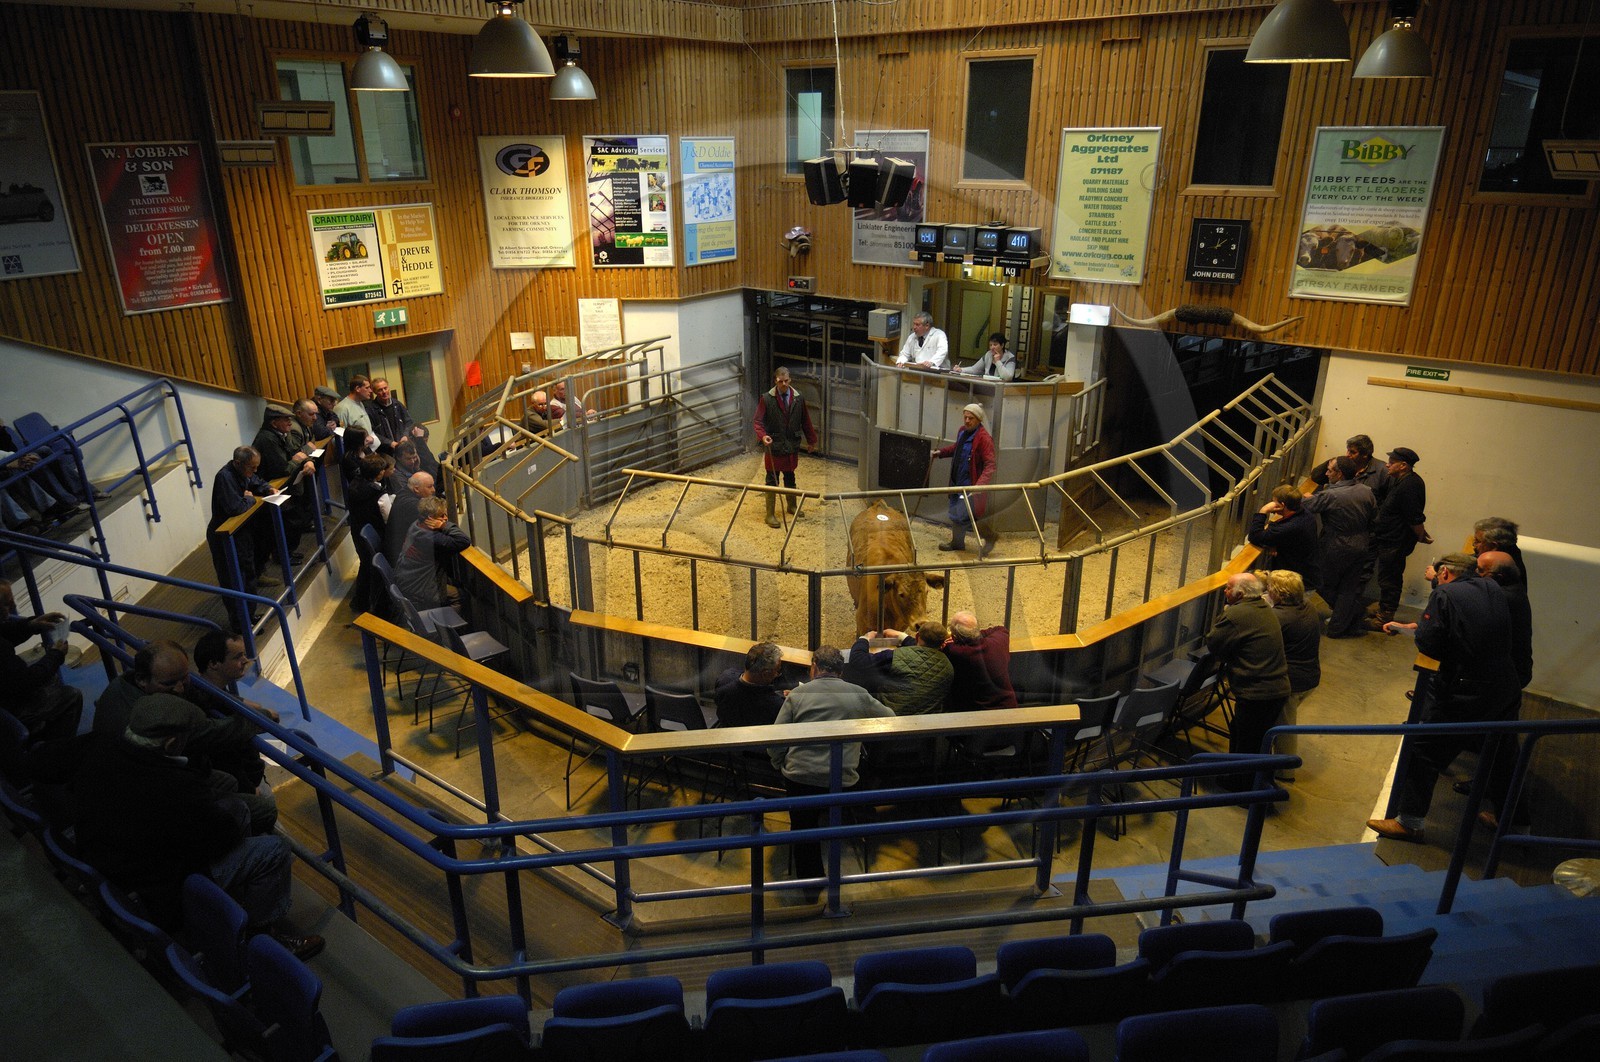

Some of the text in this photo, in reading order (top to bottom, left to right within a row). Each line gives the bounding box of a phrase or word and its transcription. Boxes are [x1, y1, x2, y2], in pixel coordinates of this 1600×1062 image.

[1087, 134, 1135, 143] Orkney
[100, 146, 190, 159] W. LOBBAN
[708, 146, 731, 158] Oddie
[1071, 145, 1149, 154] Aggregates
[1097, 155, 1119, 163] Ltd
[125, 160, 174, 172] & SON
[130, 196, 186, 206] TRADITIONAL
[128, 205, 190, 216] BUTCHER SHOP
[314, 213, 372, 225] CRANTIT DAIRY
[125, 219, 200, 234] DELICATESSEN
[857, 223, 916, 233] Linklater Engineerin
[147, 232, 186, 246] OPEN
[140, 247, 162, 256] from
[163, 245, 180, 254] 7.00
[400, 246, 431, 256] DREVER
[894, 242, 916, 250] 85100
[401, 256, 408, 264] &
[402, 261, 434, 272] HEDDLE
[1344, 283, 1405, 294] FARMERS
